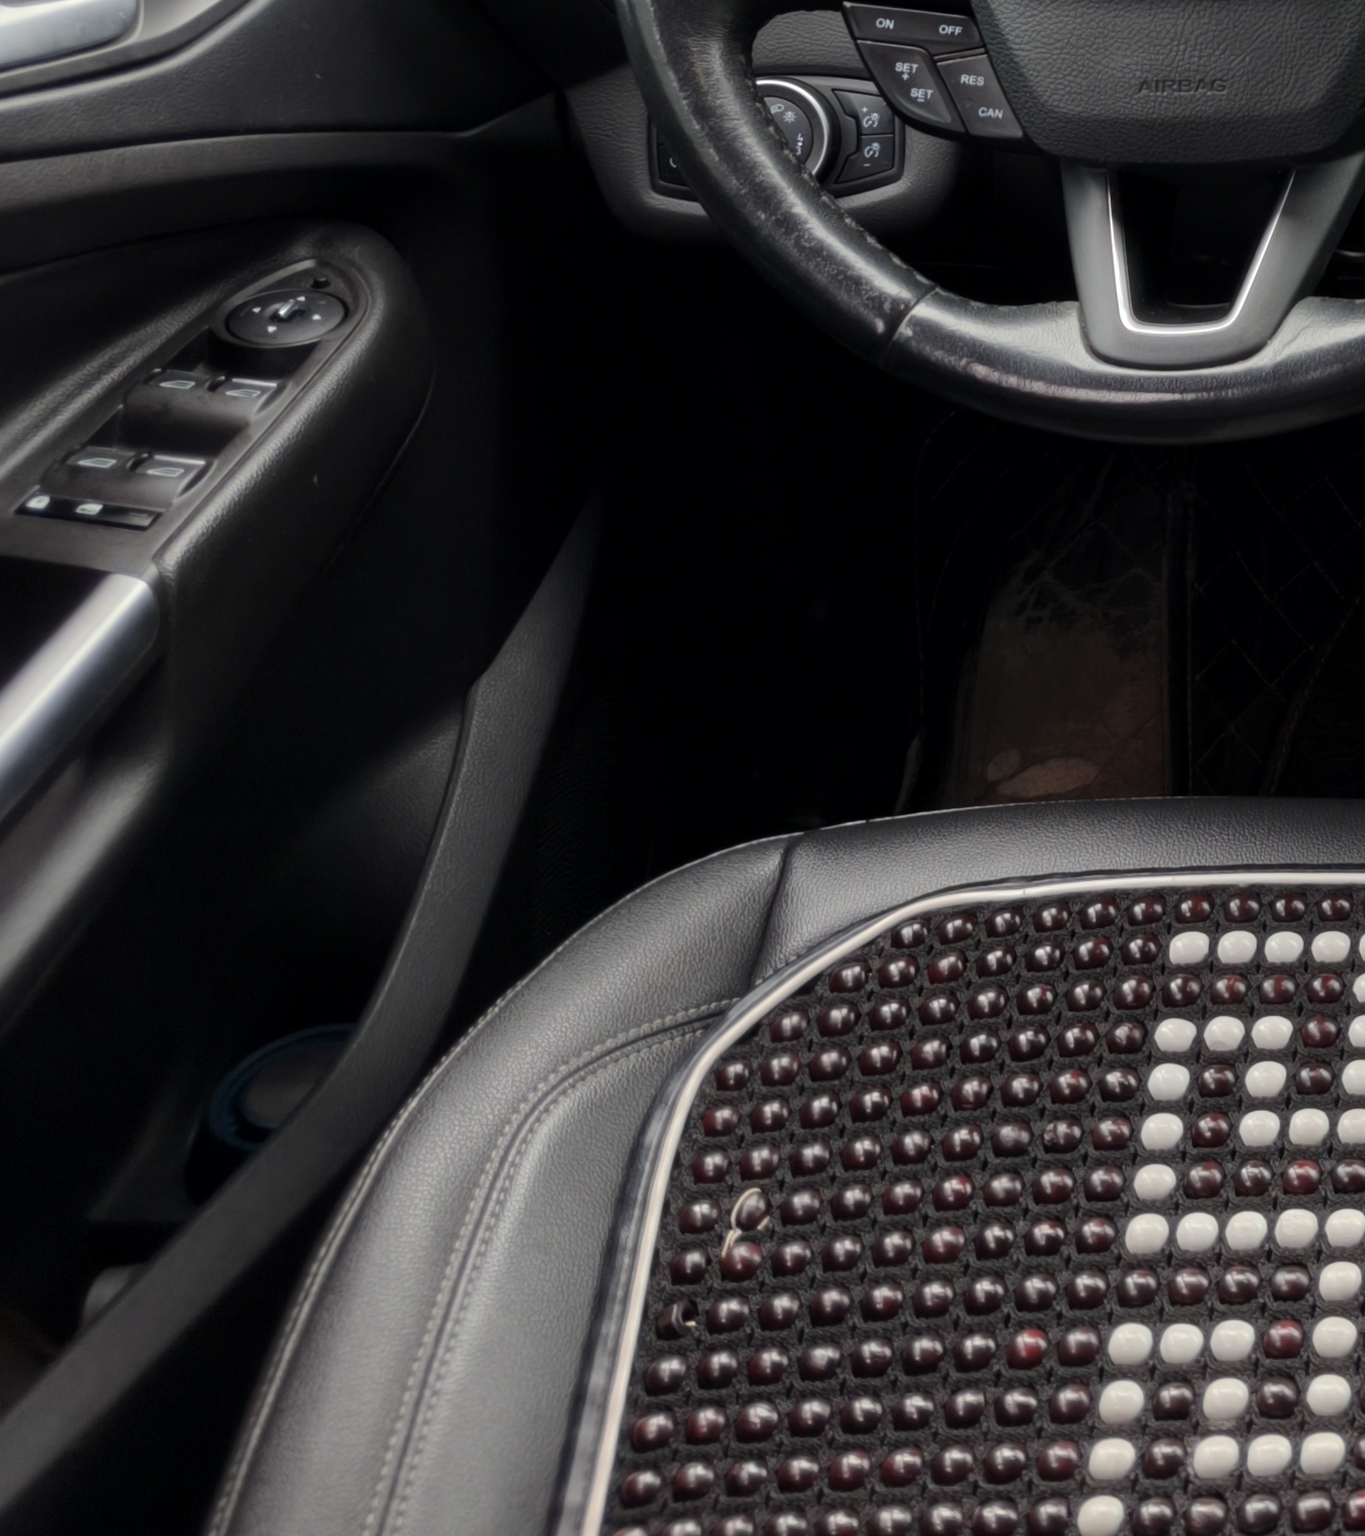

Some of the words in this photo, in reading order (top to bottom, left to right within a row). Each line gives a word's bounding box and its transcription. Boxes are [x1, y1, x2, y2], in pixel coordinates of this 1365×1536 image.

[876, 17, 894, 29] ON
[939, 24, 963, 36] OFF
[895, 61, 918, 73] SET
[960, 74, 984, 86] RES
[1137, 78, 1227, 94] AIRBAG
[910, 87, 933, 99] SET
[978, 106, 1003, 119] CAN
